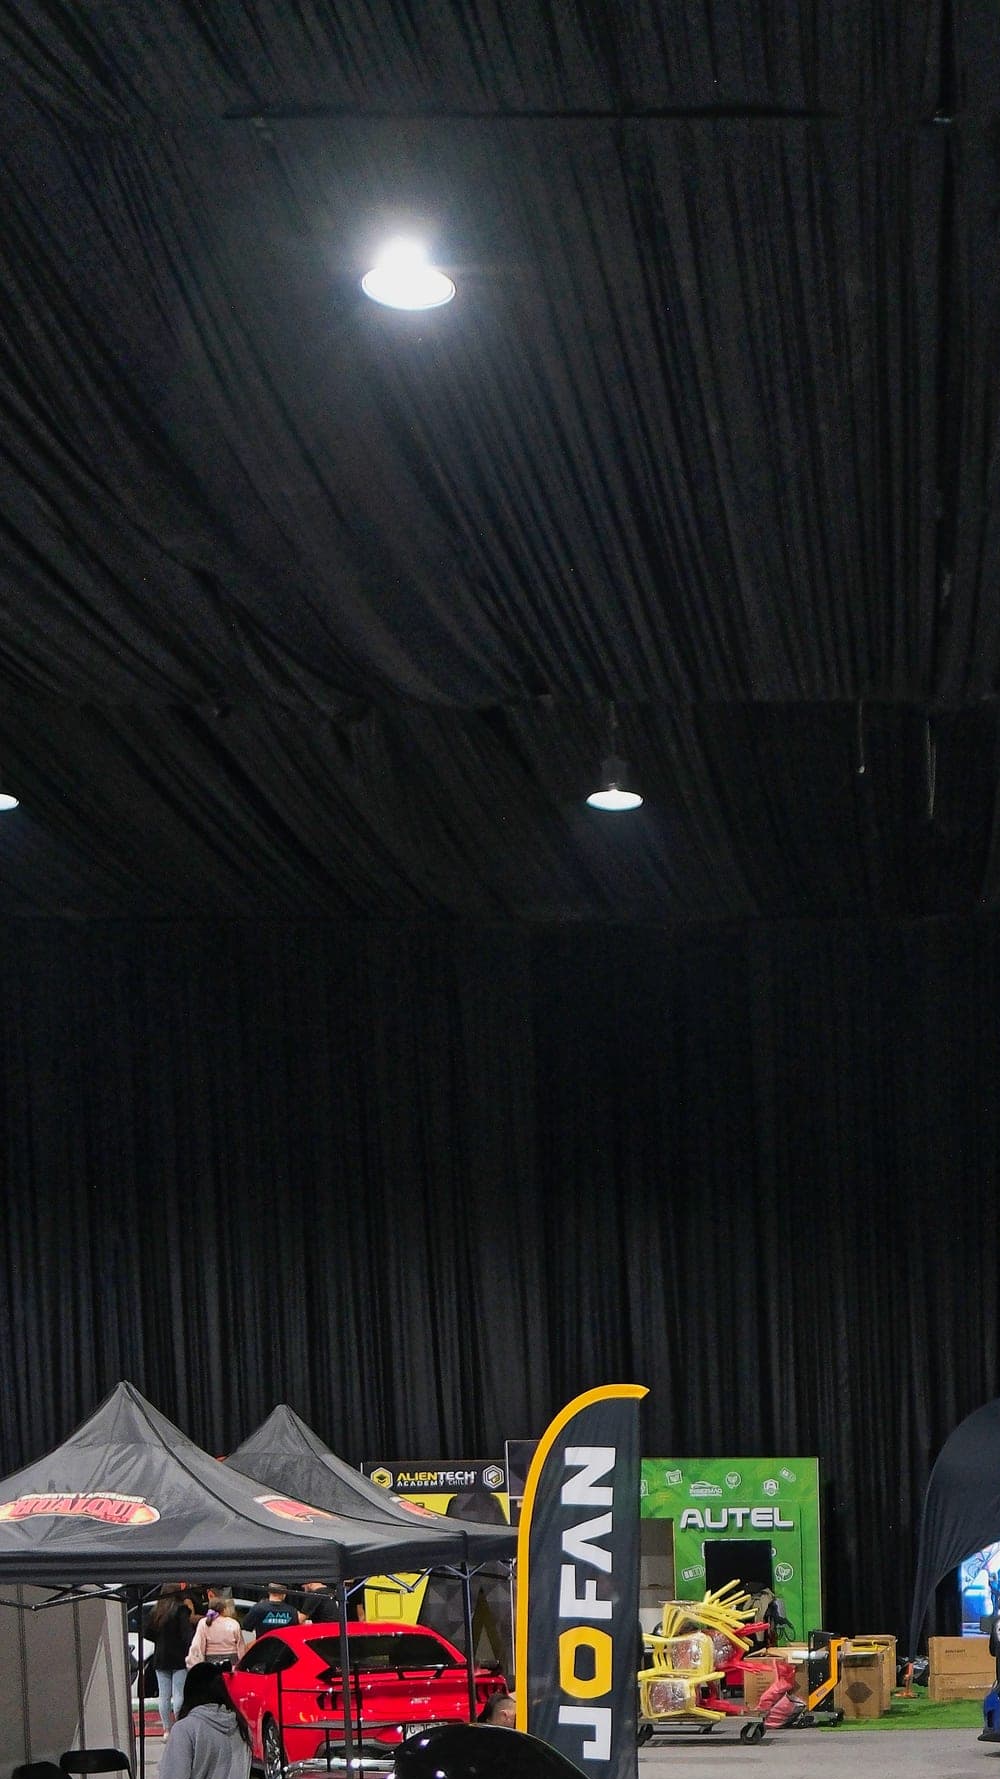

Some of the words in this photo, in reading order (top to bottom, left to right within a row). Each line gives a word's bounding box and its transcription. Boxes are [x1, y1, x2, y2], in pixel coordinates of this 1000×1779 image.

[397, 1471, 476, 1481] ALIENTECH
[680, 1507, 794, 1530] AUTEL
[558, 1446, 616, 1761] JOFAN
